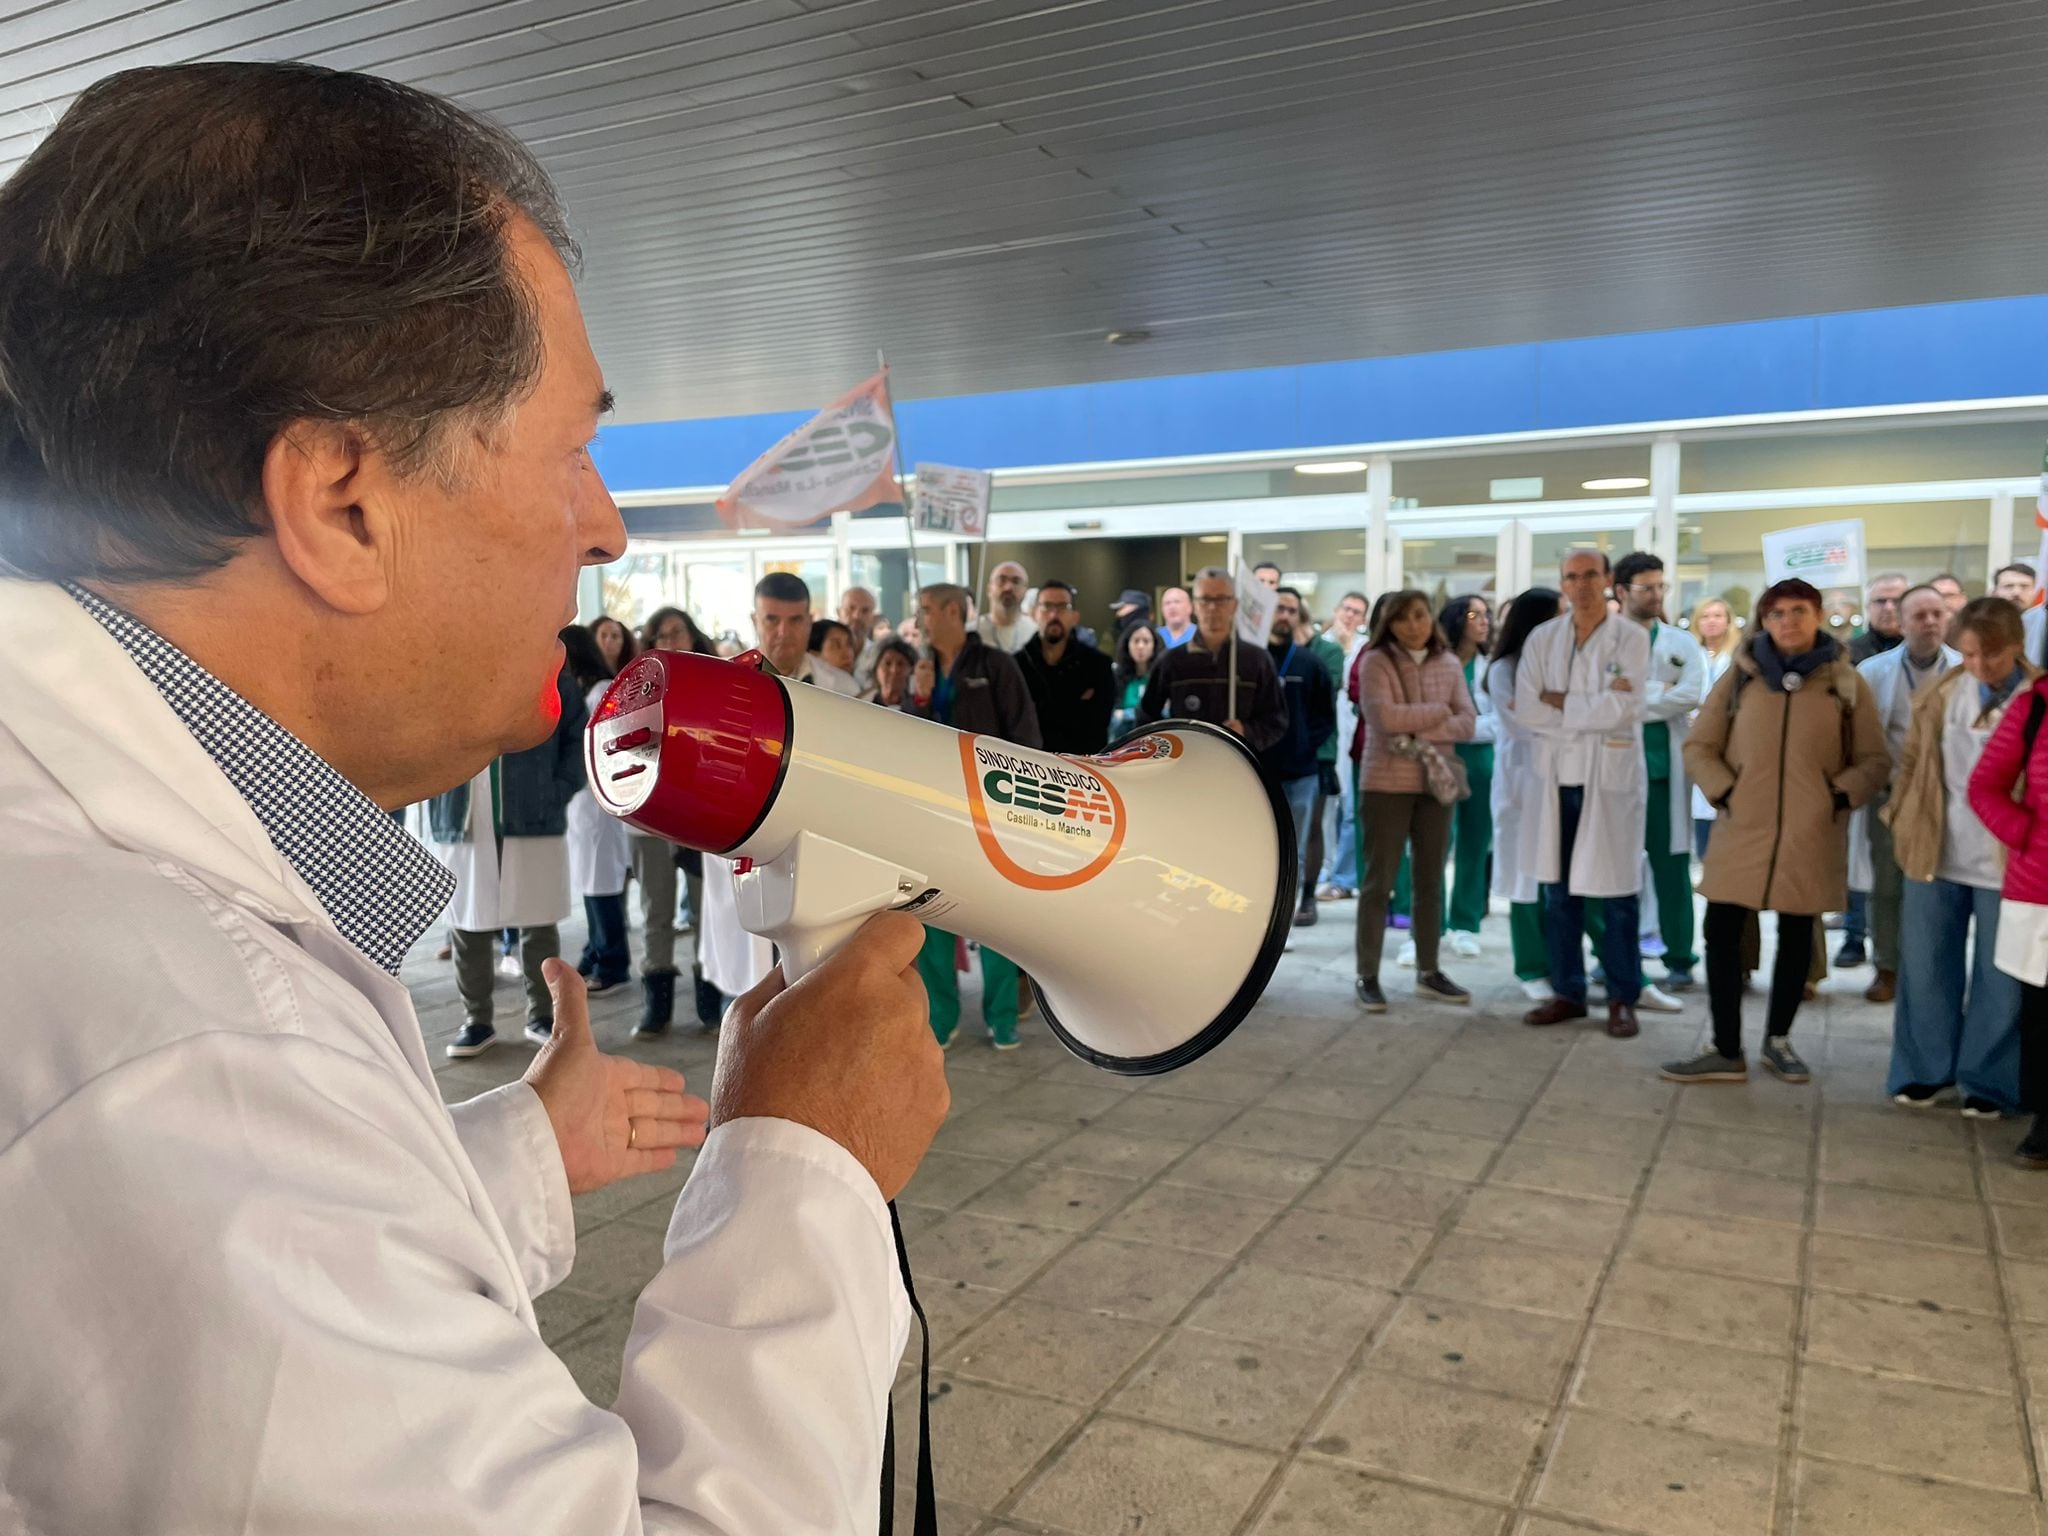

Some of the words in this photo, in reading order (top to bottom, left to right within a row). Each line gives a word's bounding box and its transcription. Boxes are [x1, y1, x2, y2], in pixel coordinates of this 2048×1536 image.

[975, 747, 1048, 780] SINDICATO
[1047, 766, 1101, 792] MÉDICO
[983, 769, 1113, 825] CESM
[1006, 810, 1038, 828] Castilla
[1045, 818, 1056, 831] La
[1058, 821, 1091, 838] Mancha
